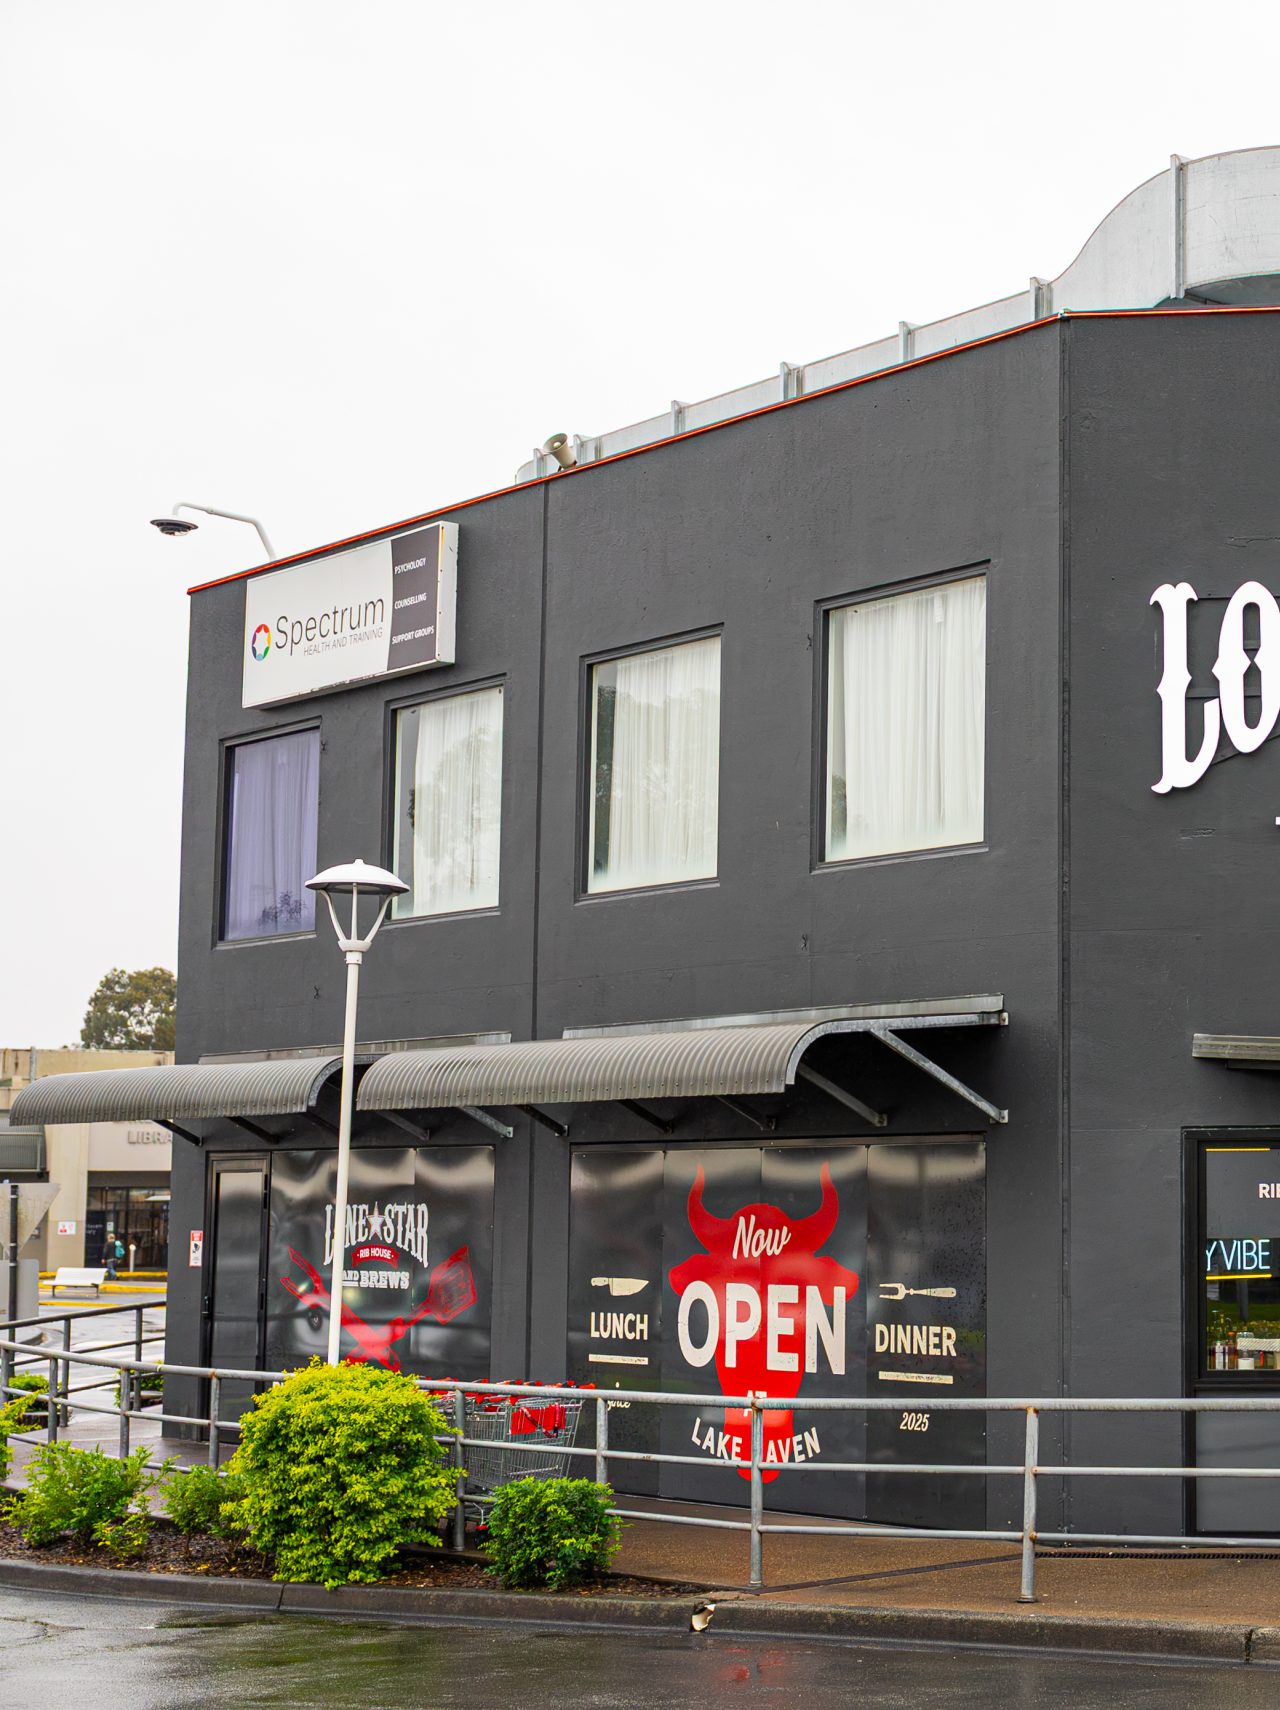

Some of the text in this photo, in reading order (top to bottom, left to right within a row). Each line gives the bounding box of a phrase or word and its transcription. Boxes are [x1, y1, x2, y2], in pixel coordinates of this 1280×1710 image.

[394, 556, 427, 575] PSYCHOLOGY
[394, 592, 427, 610] COUNSELLING
[275, 597, 385, 656] Spectrum
[303, 626, 383, 657] HEALTH AND TRAINING
[391, 625, 435, 645] SUPPORT GROUPS
[323, 1201, 429, 1269] LNE STAR
[732, 1214, 792, 1260] Now
[359, 1247, 392, 1260] RIB HOUSE
[1219, 1239, 1271, 1271] VIBE
[360, 1270, 410, 1290] BREWS
[589, 1311, 649, 1341] LUNCH
[677, 1279, 846, 1376] OPEN
[874, 1322, 958, 1358] DINNER
[899, 1412, 930, 1432] 2025
[691, 1417, 821, 1463] LAKE AVEN
